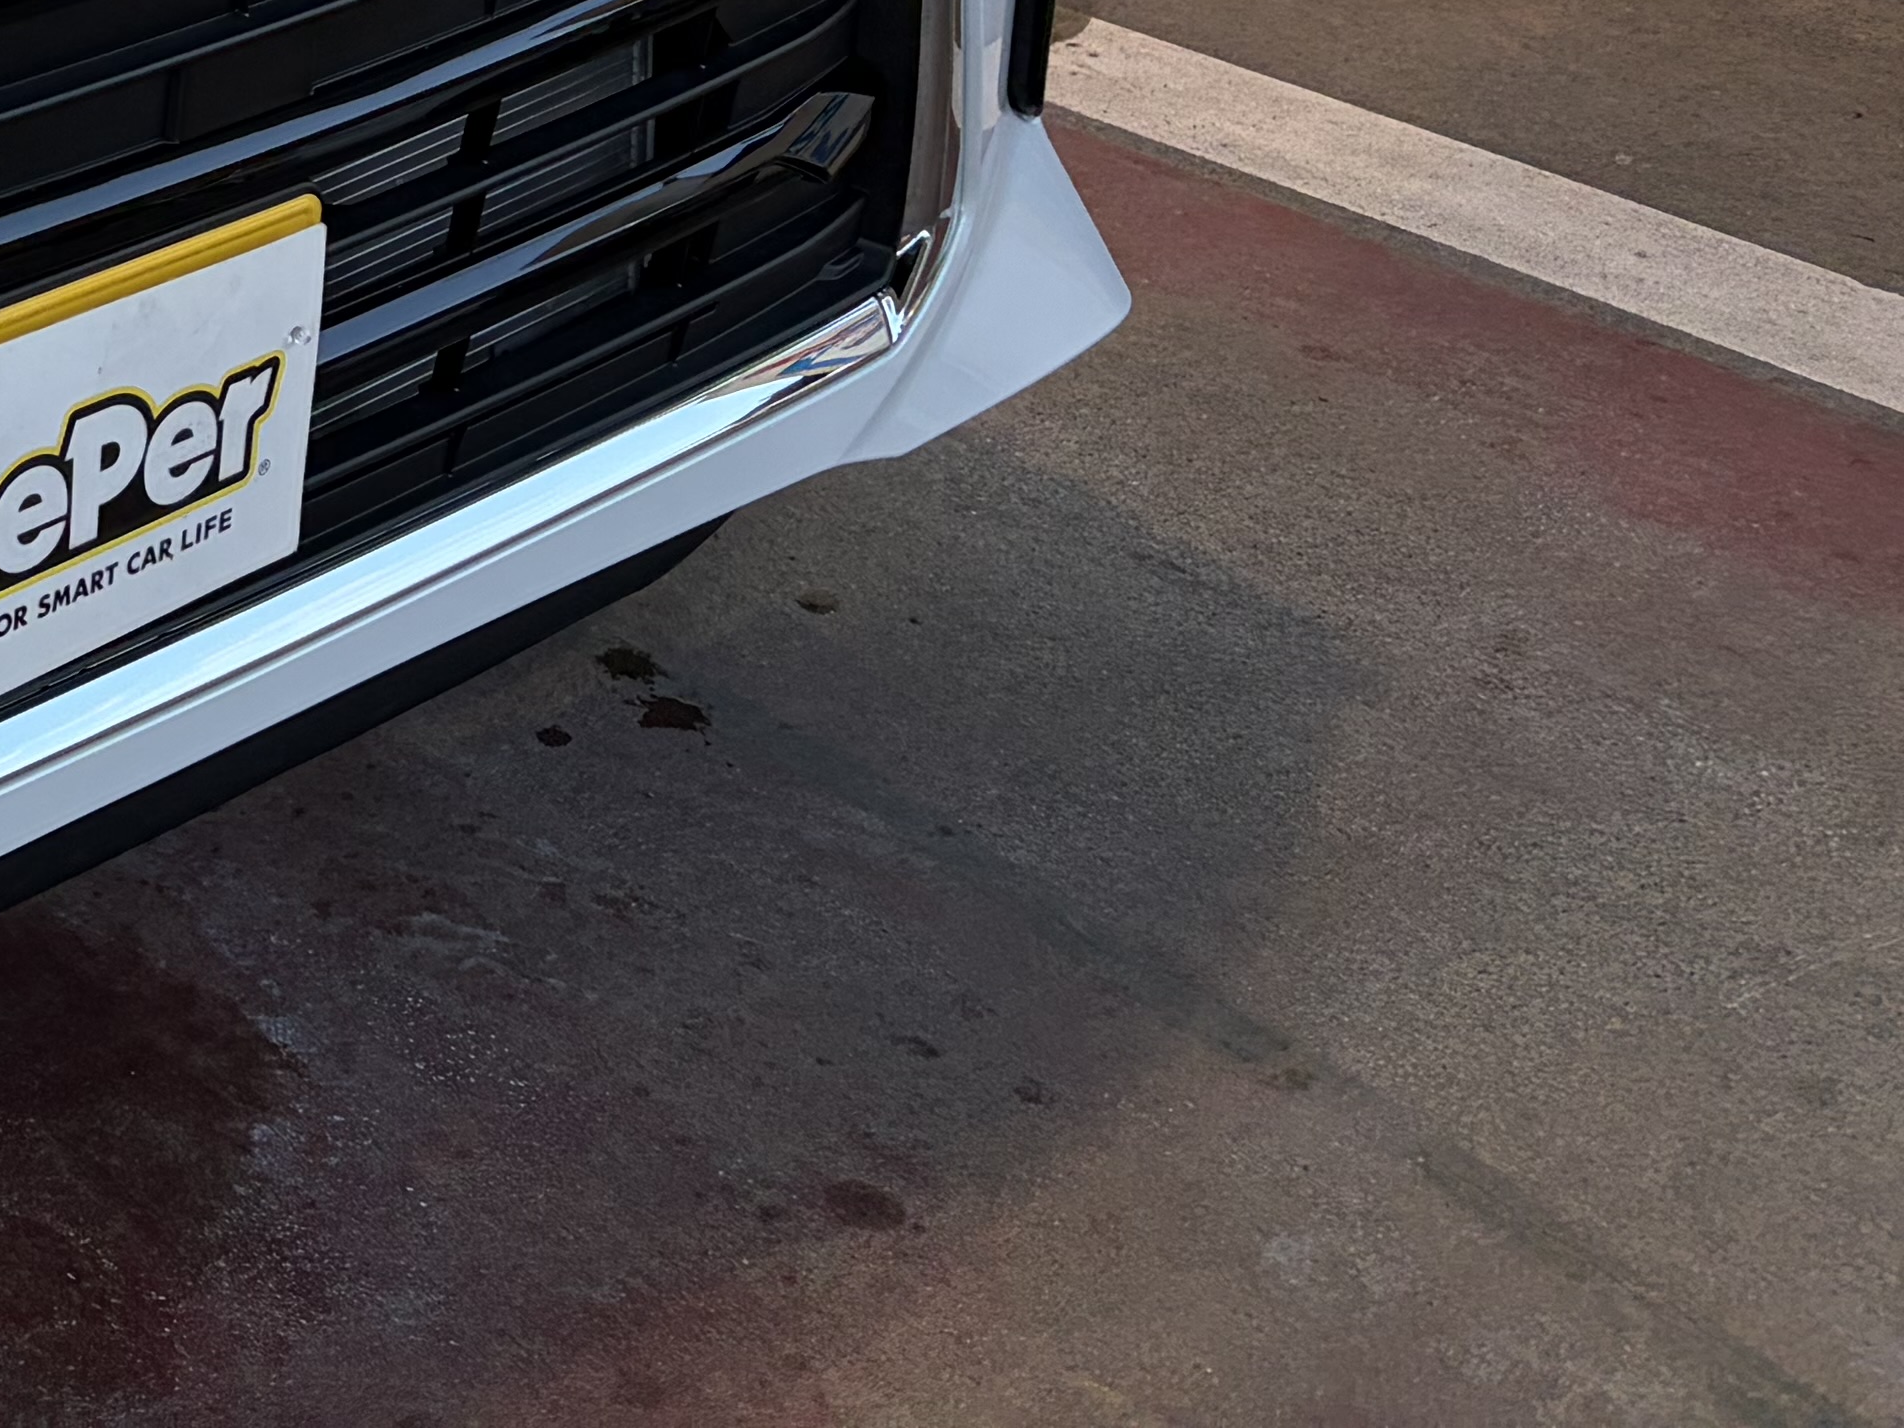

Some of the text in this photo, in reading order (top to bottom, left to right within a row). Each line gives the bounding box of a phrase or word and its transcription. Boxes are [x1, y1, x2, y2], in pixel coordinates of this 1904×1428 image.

[35, 560, 120, 621] SMART
[124, 535, 175, 579] CAR
[179, 507, 234, 554] LIFE
